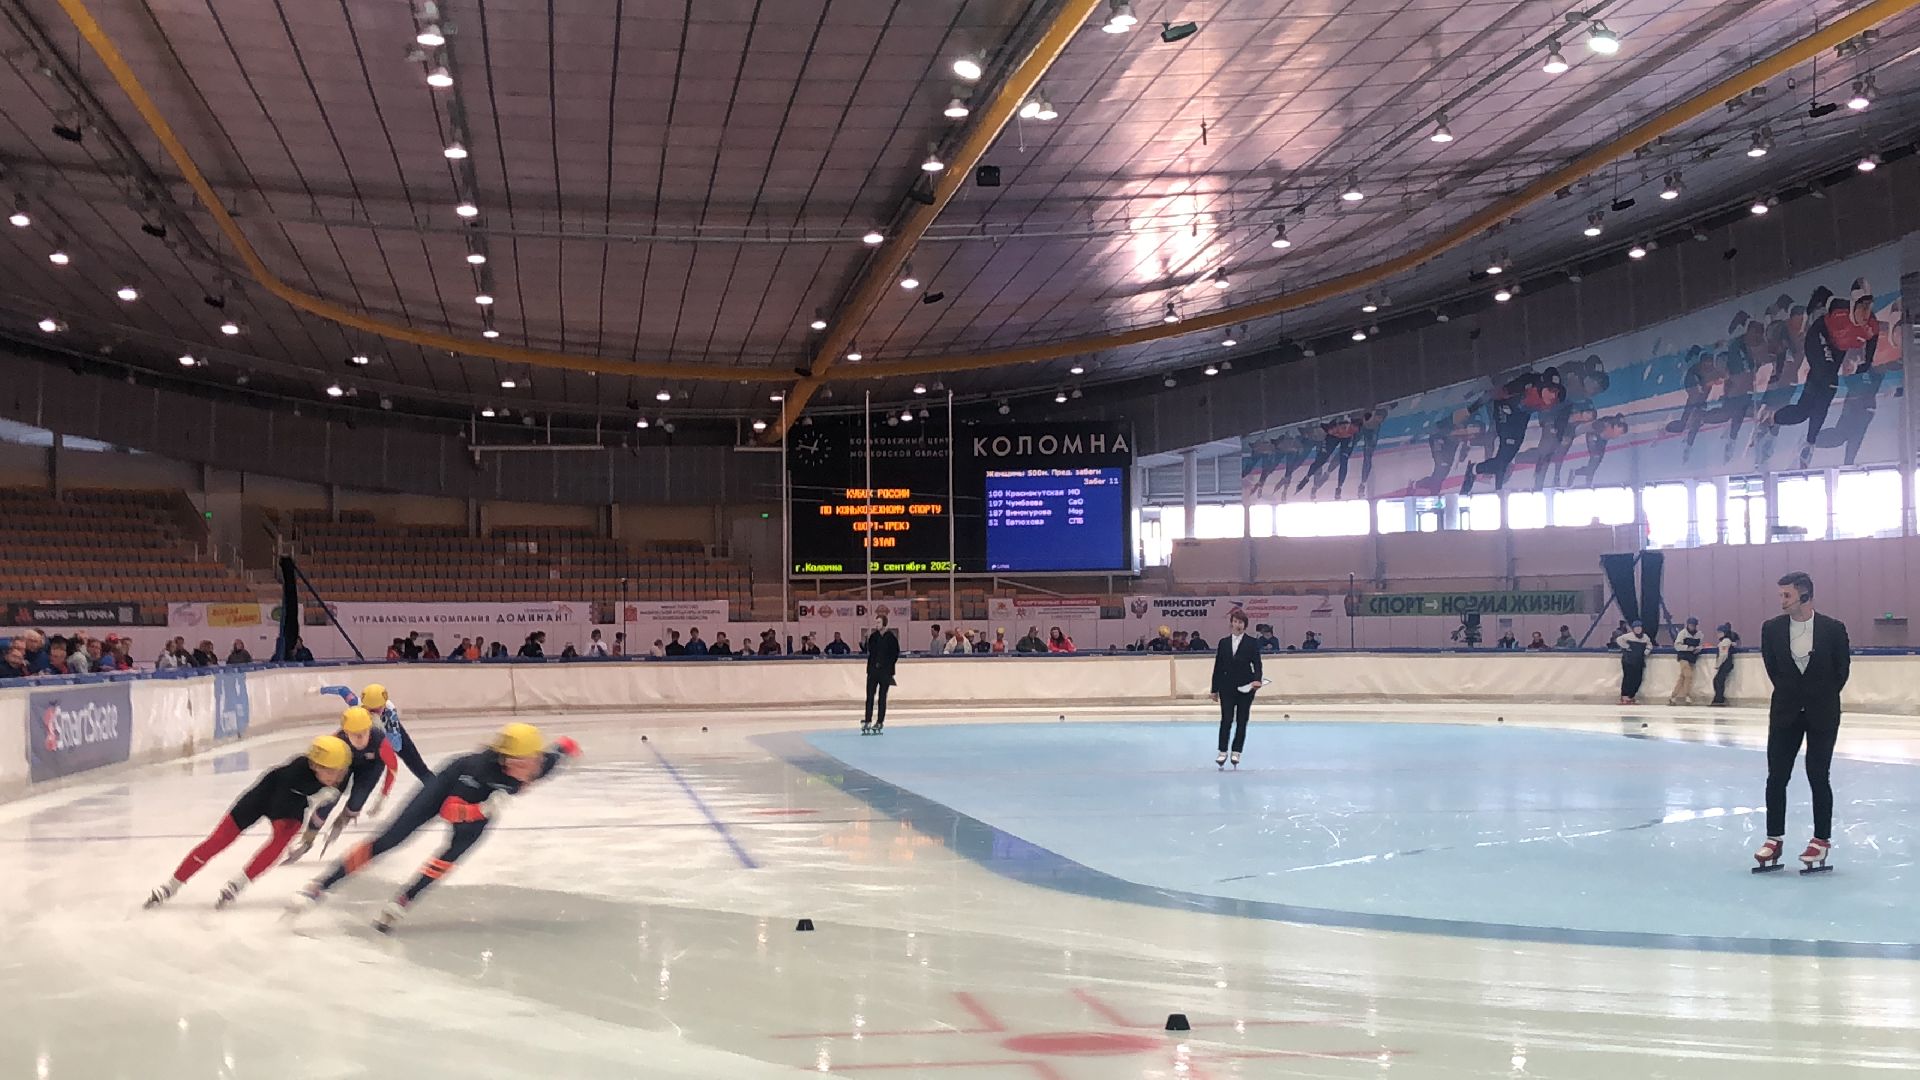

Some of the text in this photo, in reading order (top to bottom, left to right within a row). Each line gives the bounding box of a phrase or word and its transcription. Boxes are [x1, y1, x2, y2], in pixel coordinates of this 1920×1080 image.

[927, 437, 953, 445] ЦЕНТ
[973, 434, 1129, 457] КОЛОМНА
[914, 449, 953, 457] ОБЛАСТ
[1083, 477, 1106, 486] Забег
[877, 488, 910, 499] РОССИИ
[820, 505, 832, 515] ПО
[909, 504, 942, 515] СПОРТУ
[873, 537, 895, 547] ЭТАП
[795, 562, 842, 573] г.Коломна
[883, 561, 926, 573] сентября
[1153, 599, 1216, 608] МИНСПОРТ
[1369, 597, 1425, 614] СПОРТ
[1508, 594, 1576, 613] ЖИЗНИ
[352, 613, 568, 624] УПРАВЛЯЮЩАЯ КОМПАНИЯ ДОМИНАНТ
[1162, 609, 1208, 617] РОССИИ
[53, 701, 119, 751] SmartSkate
